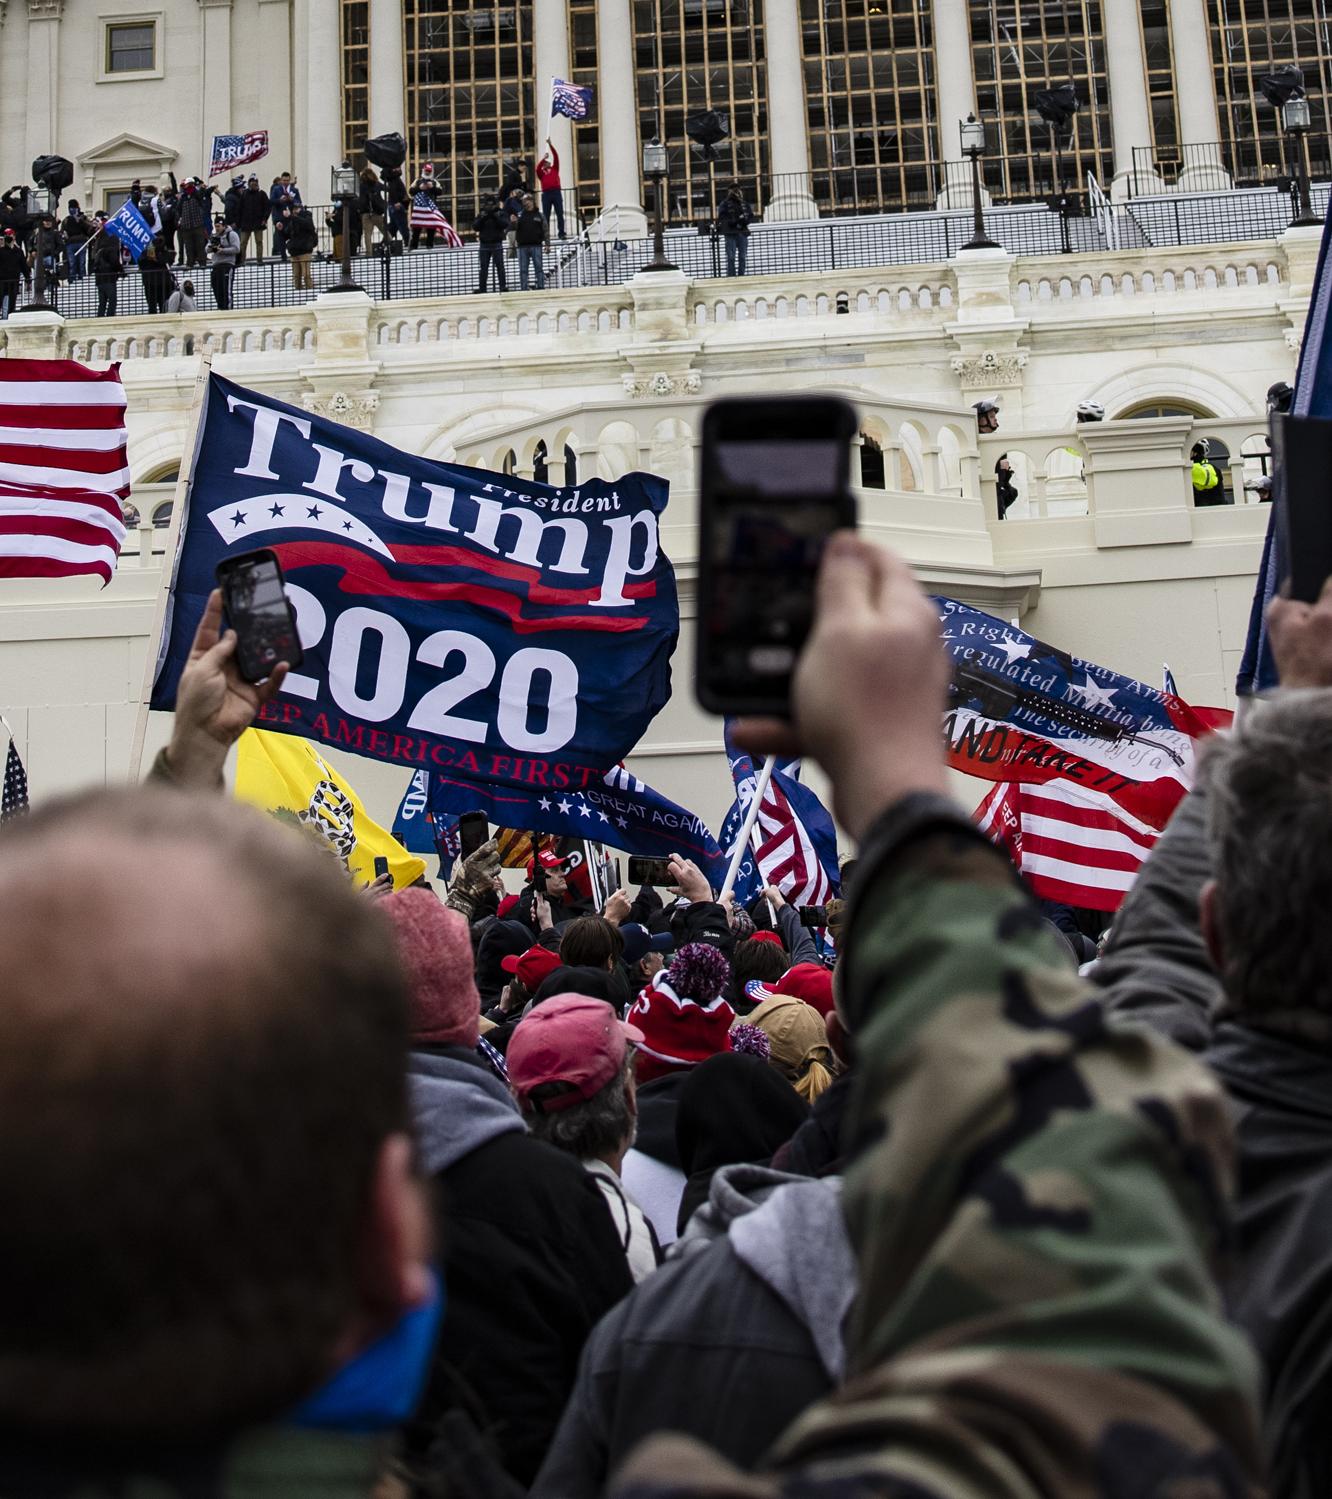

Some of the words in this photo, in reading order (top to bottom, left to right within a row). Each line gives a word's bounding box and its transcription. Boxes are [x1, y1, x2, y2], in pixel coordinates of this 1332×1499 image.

[228, 394, 659, 607] Trump
[960, 622, 1026, 643] Right
[279, 582, 579, 753] 2020
[953, 645, 1058, 693] regulated
[1140, 714, 1191, 756] being
[1071, 655, 1121, 684] Bear
[1125, 679, 1184, 715] Arms.
[257, 700, 302, 724] EP
[311, 712, 481, 772] AMERICA
[1009, 733, 1094, 780] TAKE
[1093, 772, 1141, 794] IT
[587, 789, 647, 819] GREAT
